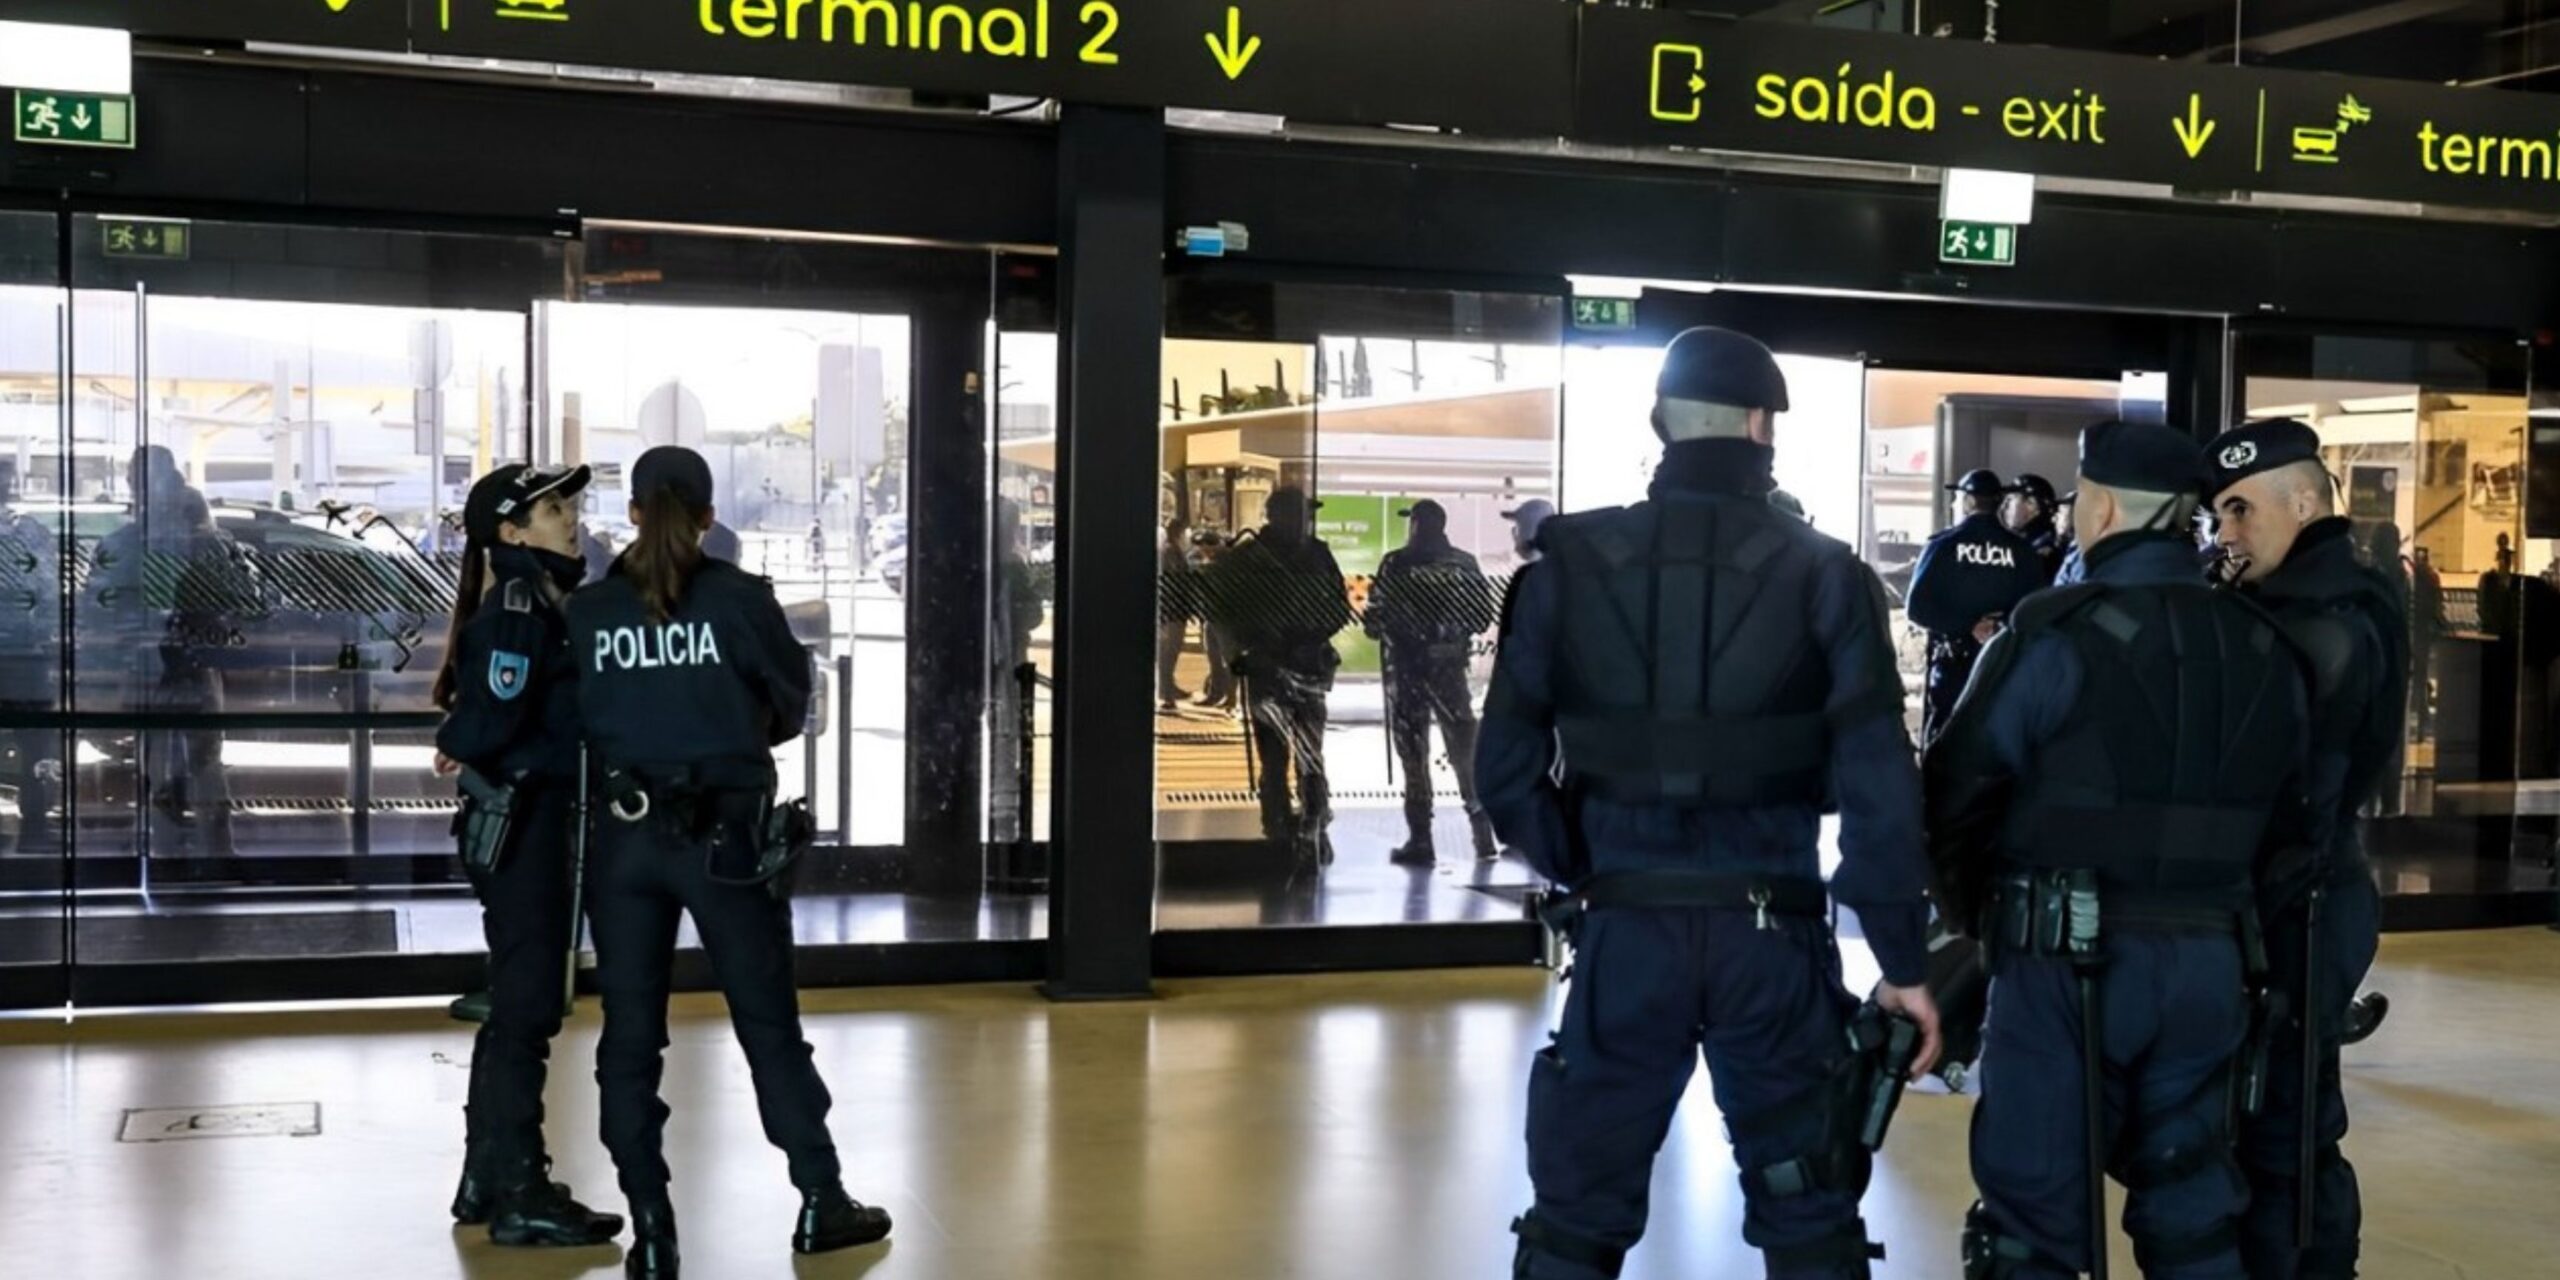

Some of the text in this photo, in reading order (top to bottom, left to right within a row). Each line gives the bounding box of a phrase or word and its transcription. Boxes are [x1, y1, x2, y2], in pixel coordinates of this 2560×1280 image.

[698, 0, 1119, 64] terminal 2
[1754, 62, 1936, 131] saída
[2002, 89, 2105, 143] exit
